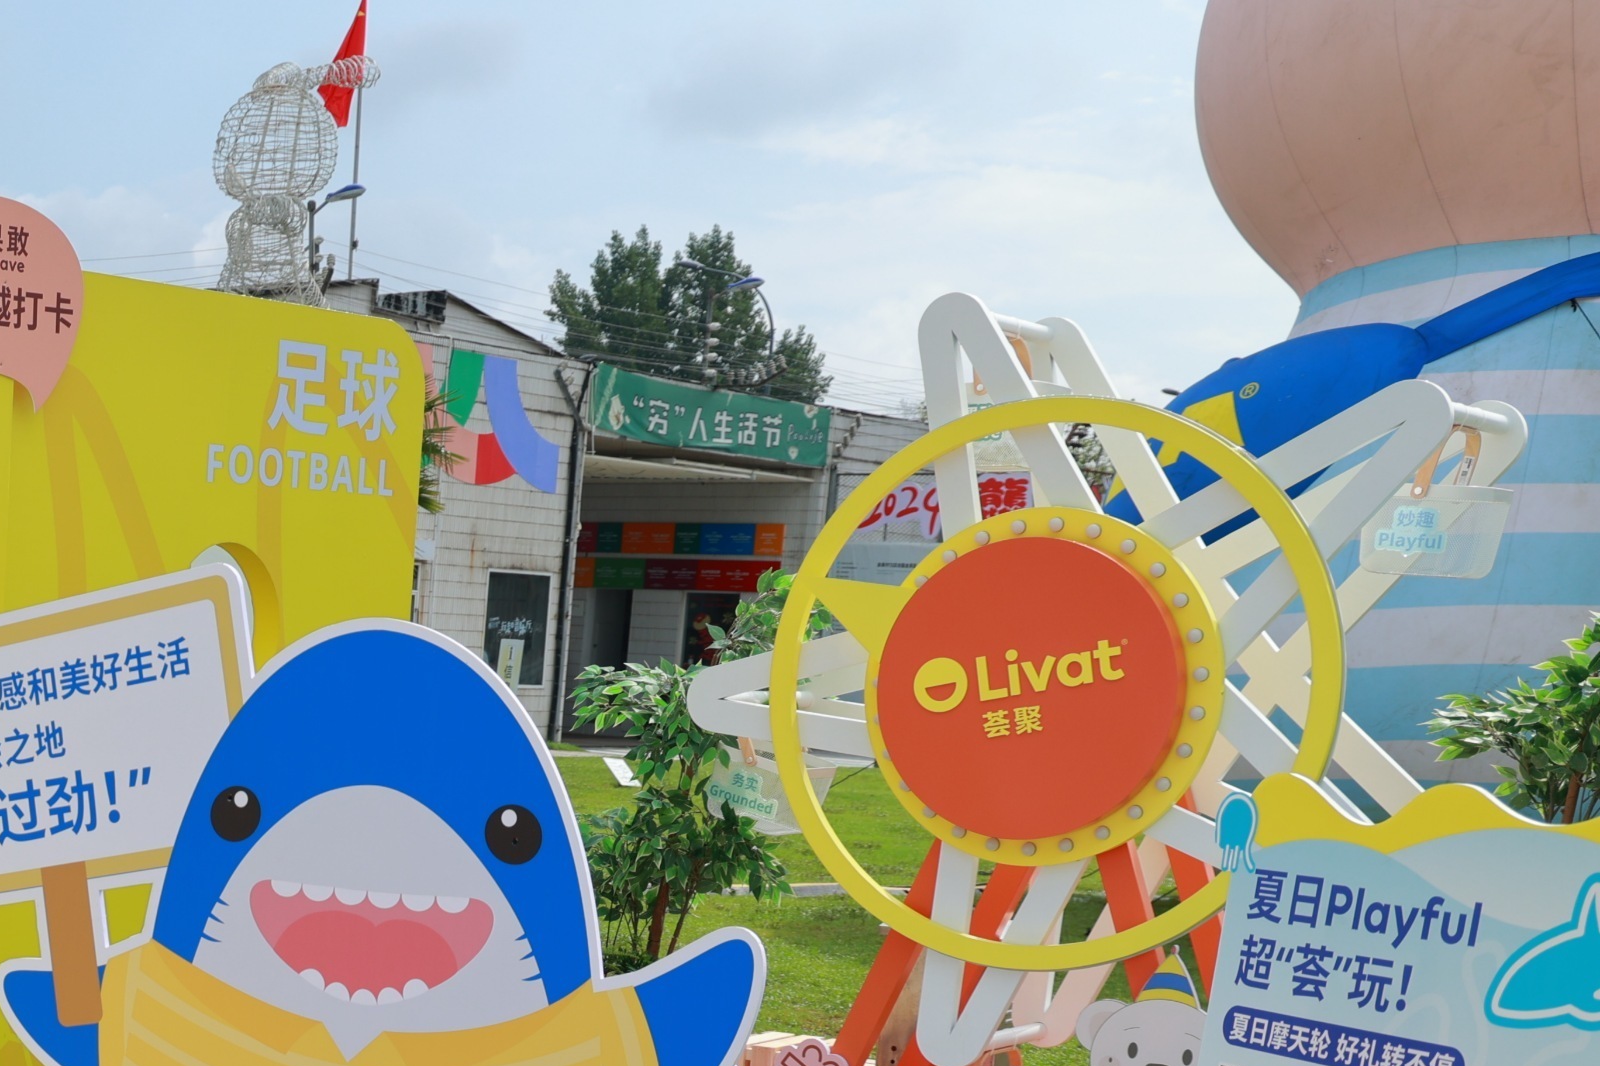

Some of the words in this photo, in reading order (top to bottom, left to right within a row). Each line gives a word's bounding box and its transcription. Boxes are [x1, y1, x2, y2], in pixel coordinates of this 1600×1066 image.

[268, 338, 399, 442] 足球
[206, 444, 393, 496] FOOTBALL
[1397, 510, 1434, 529] 妙趣
[1378, 532, 1443, 553] Playful
[976, 639, 1125, 702] Livat
[982, 705, 1044, 739] 荟聚
[709, 785, 774, 814] Grounded
[732, 773, 759, 792] 务实
[1247, 869, 1483, 948] 夏日Playful
[1229, 1012, 1331, 1060] 夏日摩天轮
